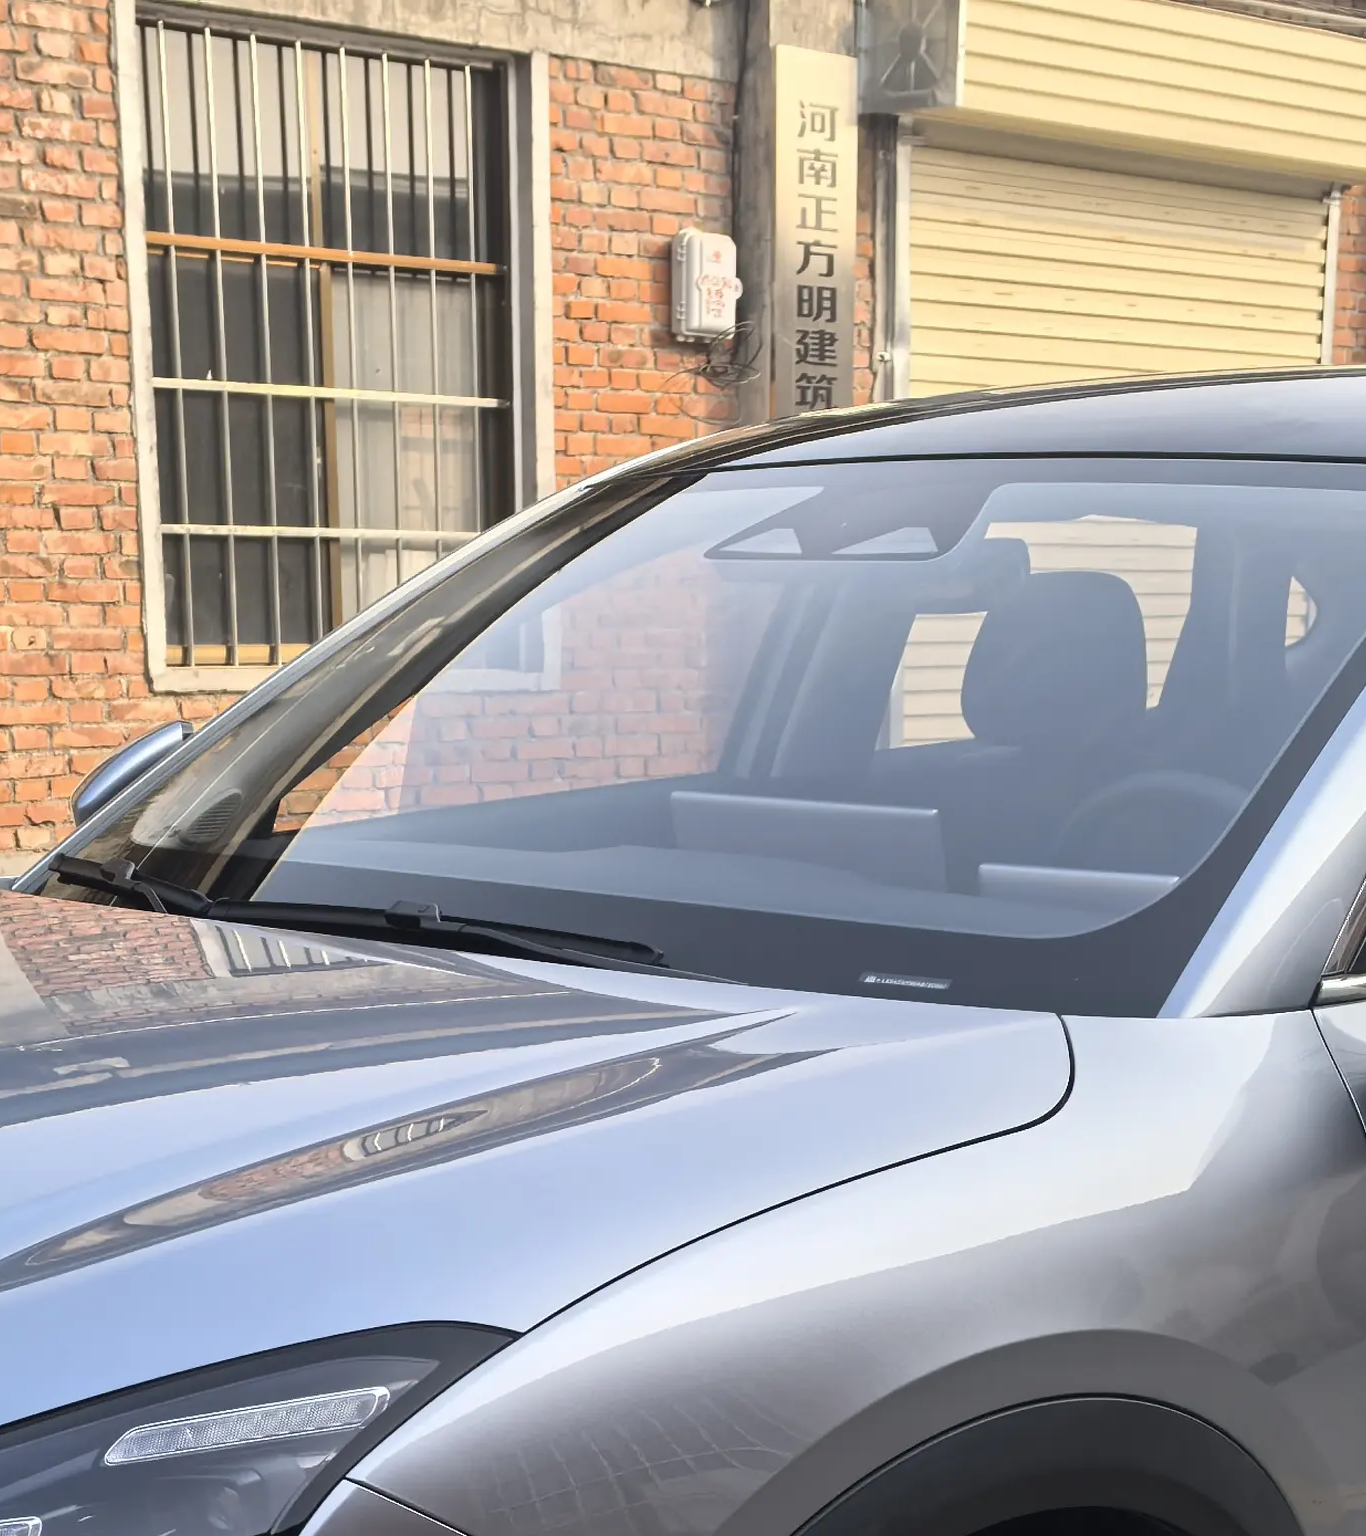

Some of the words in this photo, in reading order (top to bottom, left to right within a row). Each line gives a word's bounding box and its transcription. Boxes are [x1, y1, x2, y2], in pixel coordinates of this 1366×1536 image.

[795, 100, 839, 409] 河南正方明建筑
